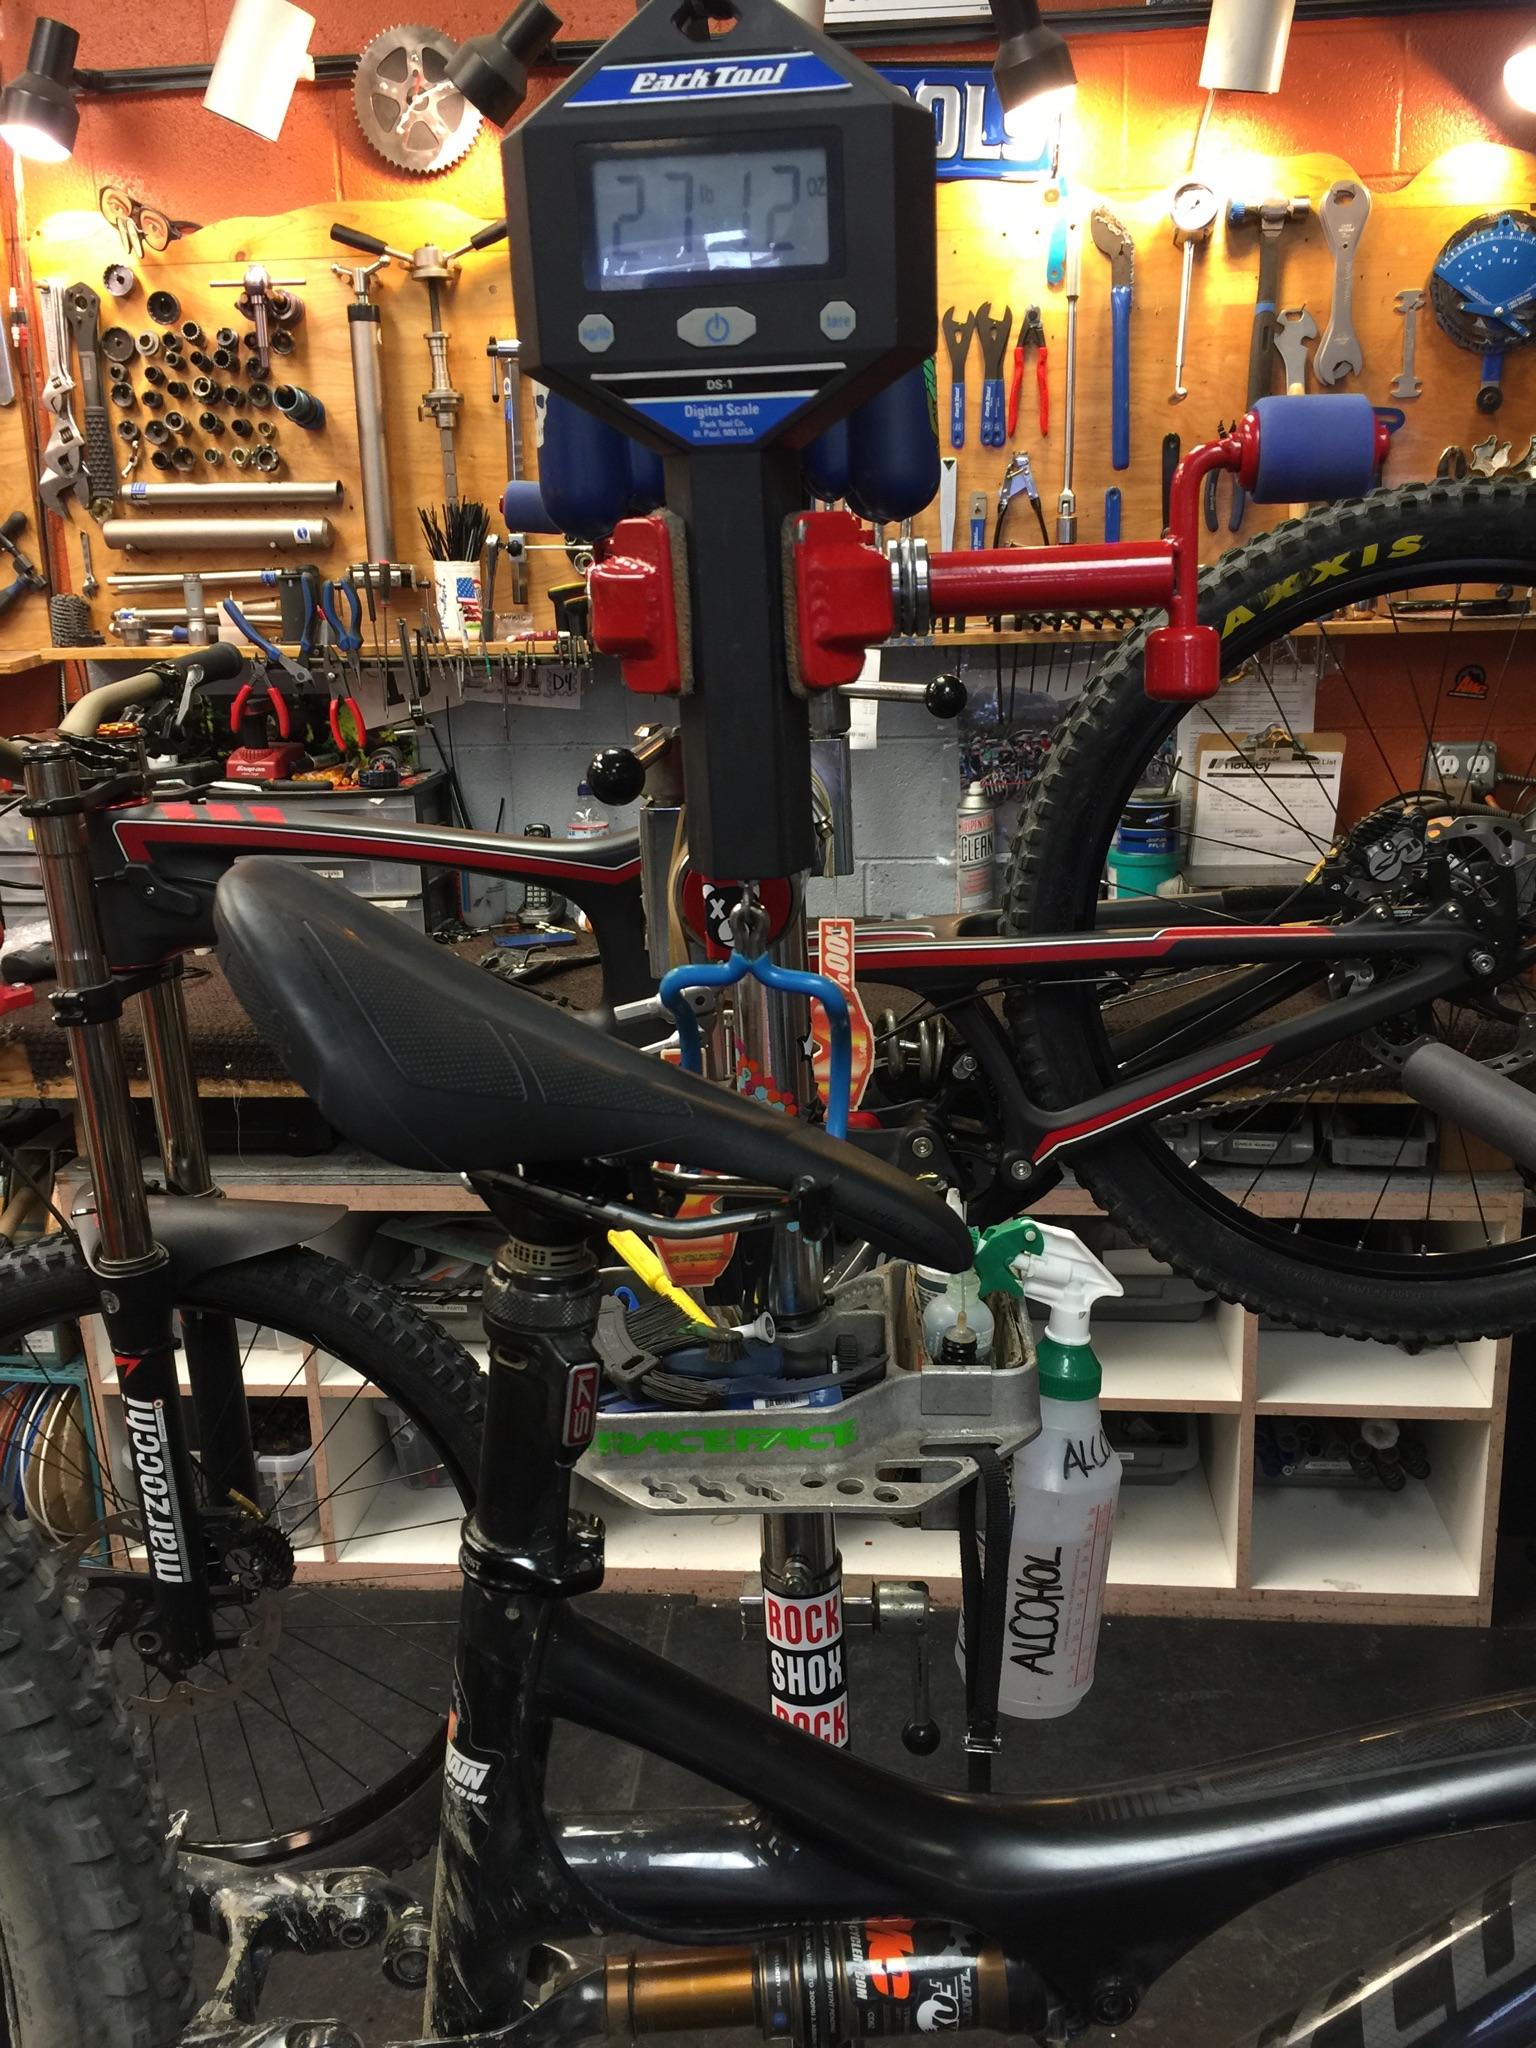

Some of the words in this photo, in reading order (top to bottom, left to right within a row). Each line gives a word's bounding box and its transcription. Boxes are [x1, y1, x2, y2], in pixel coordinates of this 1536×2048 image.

[630, 68, 712, 94] Park
[713, 62, 788, 88] Tool
[612, 170, 694, 260] 27
[741, 164, 801, 250] 12
[706, 378, 734, 391] DS-1
[684, 403, 724, 420] Digital
[726, 402, 760, 417] Scale
[1222, 535, 1424, 640] AXXIS
[122, 1393, 184, 1584] marzocchi
[767, 1595, 840, 1646] ROCK
[1009, 1546, 1065, 1676] ALCOHOL
[770, 1645, 843, 1696] SHOX
